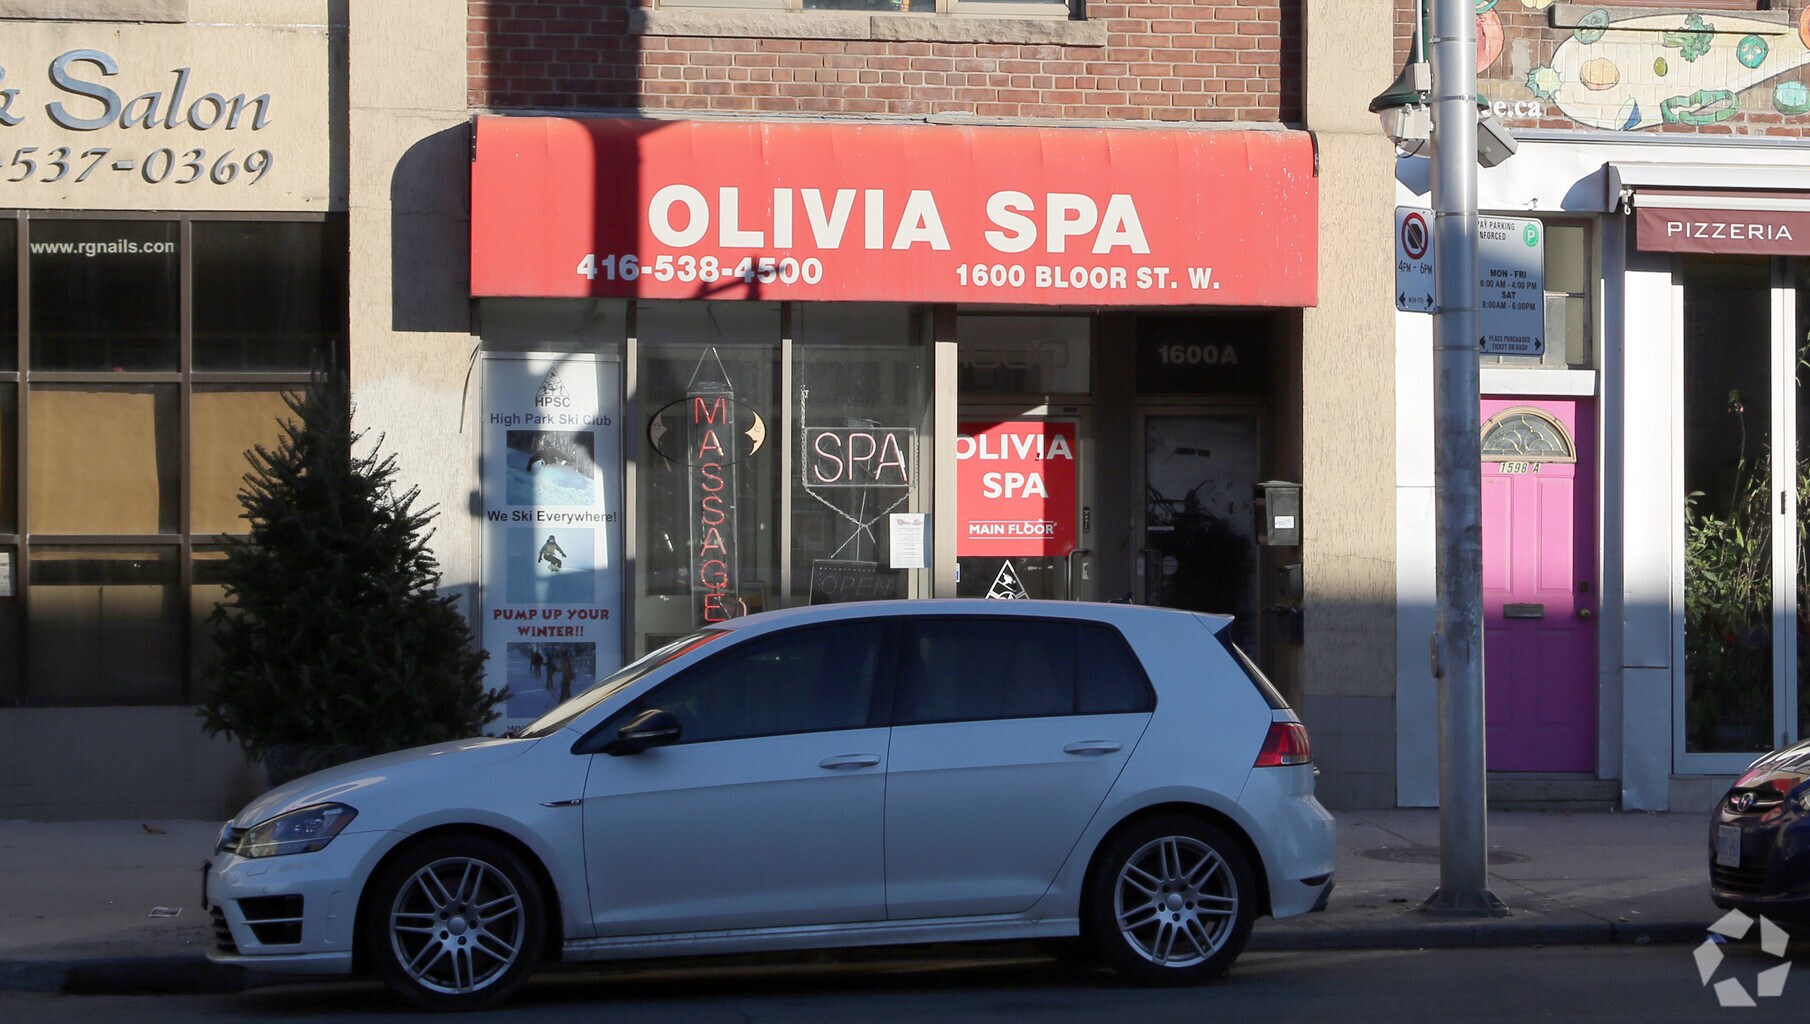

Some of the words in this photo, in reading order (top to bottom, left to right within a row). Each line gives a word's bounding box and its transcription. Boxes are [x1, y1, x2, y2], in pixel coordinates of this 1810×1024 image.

[45, 49, 272, 131] Salon
[0, 146, 274, 186] 537-0369
[647, 183, 951, 251] OLIVIA
[984, 189, 1151, 254] SPA
[1489, 221, 1516, 231] PARKING
[1479, 231, 1507, 241] NFORCED
[1667, 220, 1793, 241] PIZZERIA
[576, 253, 823, 285] 416-538-4500
[1398, 260, 1412, 273] 4PM
[1420, 262, 1433, 275] 6PM
[1490, 269, 1508, 278] MON
[1514, 270, 1527, 279] FRI
[955, 263, 1025, 288] 1600
[1034, 264, 1127, 289] BLOOR
[1136, 266, 1178, 290] ST.
[1187, 266, 1221, 290] W.
[1480, 279, 1494, 288] 8:00
[1495, 280, 1506, 289] AM
[1511, 281, 1525, 290] 4:00
[1526, 282, 1537, 290] PM
[1501, 290, 1517, 299] SAT
[1482, 300, 1507, 310] 8:00AM
[1511, 302, 1536, 311] 6:00PM
[1157, 344, 1239, 365] 1600A
[535, 396, 571, 408] HPSC
[490, 413, 521, 427] High
[525, 413, 555, 425] Park
[558, 413, 579, 425] Ski
[582, 414, 612, 426] Club
[956, 433, 1074, 460] OLIVIA
[813, 432, 908, 483] SPA
[1501, 461, 1528, 474] 1598
[1532, 462, 1540, 474] A
[982, 471, 1049, 499] SPA
[694, 396, 728, 622] MASSAGE
[487, 510, 508, 522] We
[512, 510, 533, 522] Ski
[536, 510, 617, 525] Everywhere!
[969, 523, 1005, 535] MAIN
[1008, 523, 1054, 535] FLOOR
[493, 608, 538, 621] PUMP
[542, 608, 563, 620] UP
[567, 608, 610, 621] YOUR
[517, 625, 585, 637] WINTER!!
